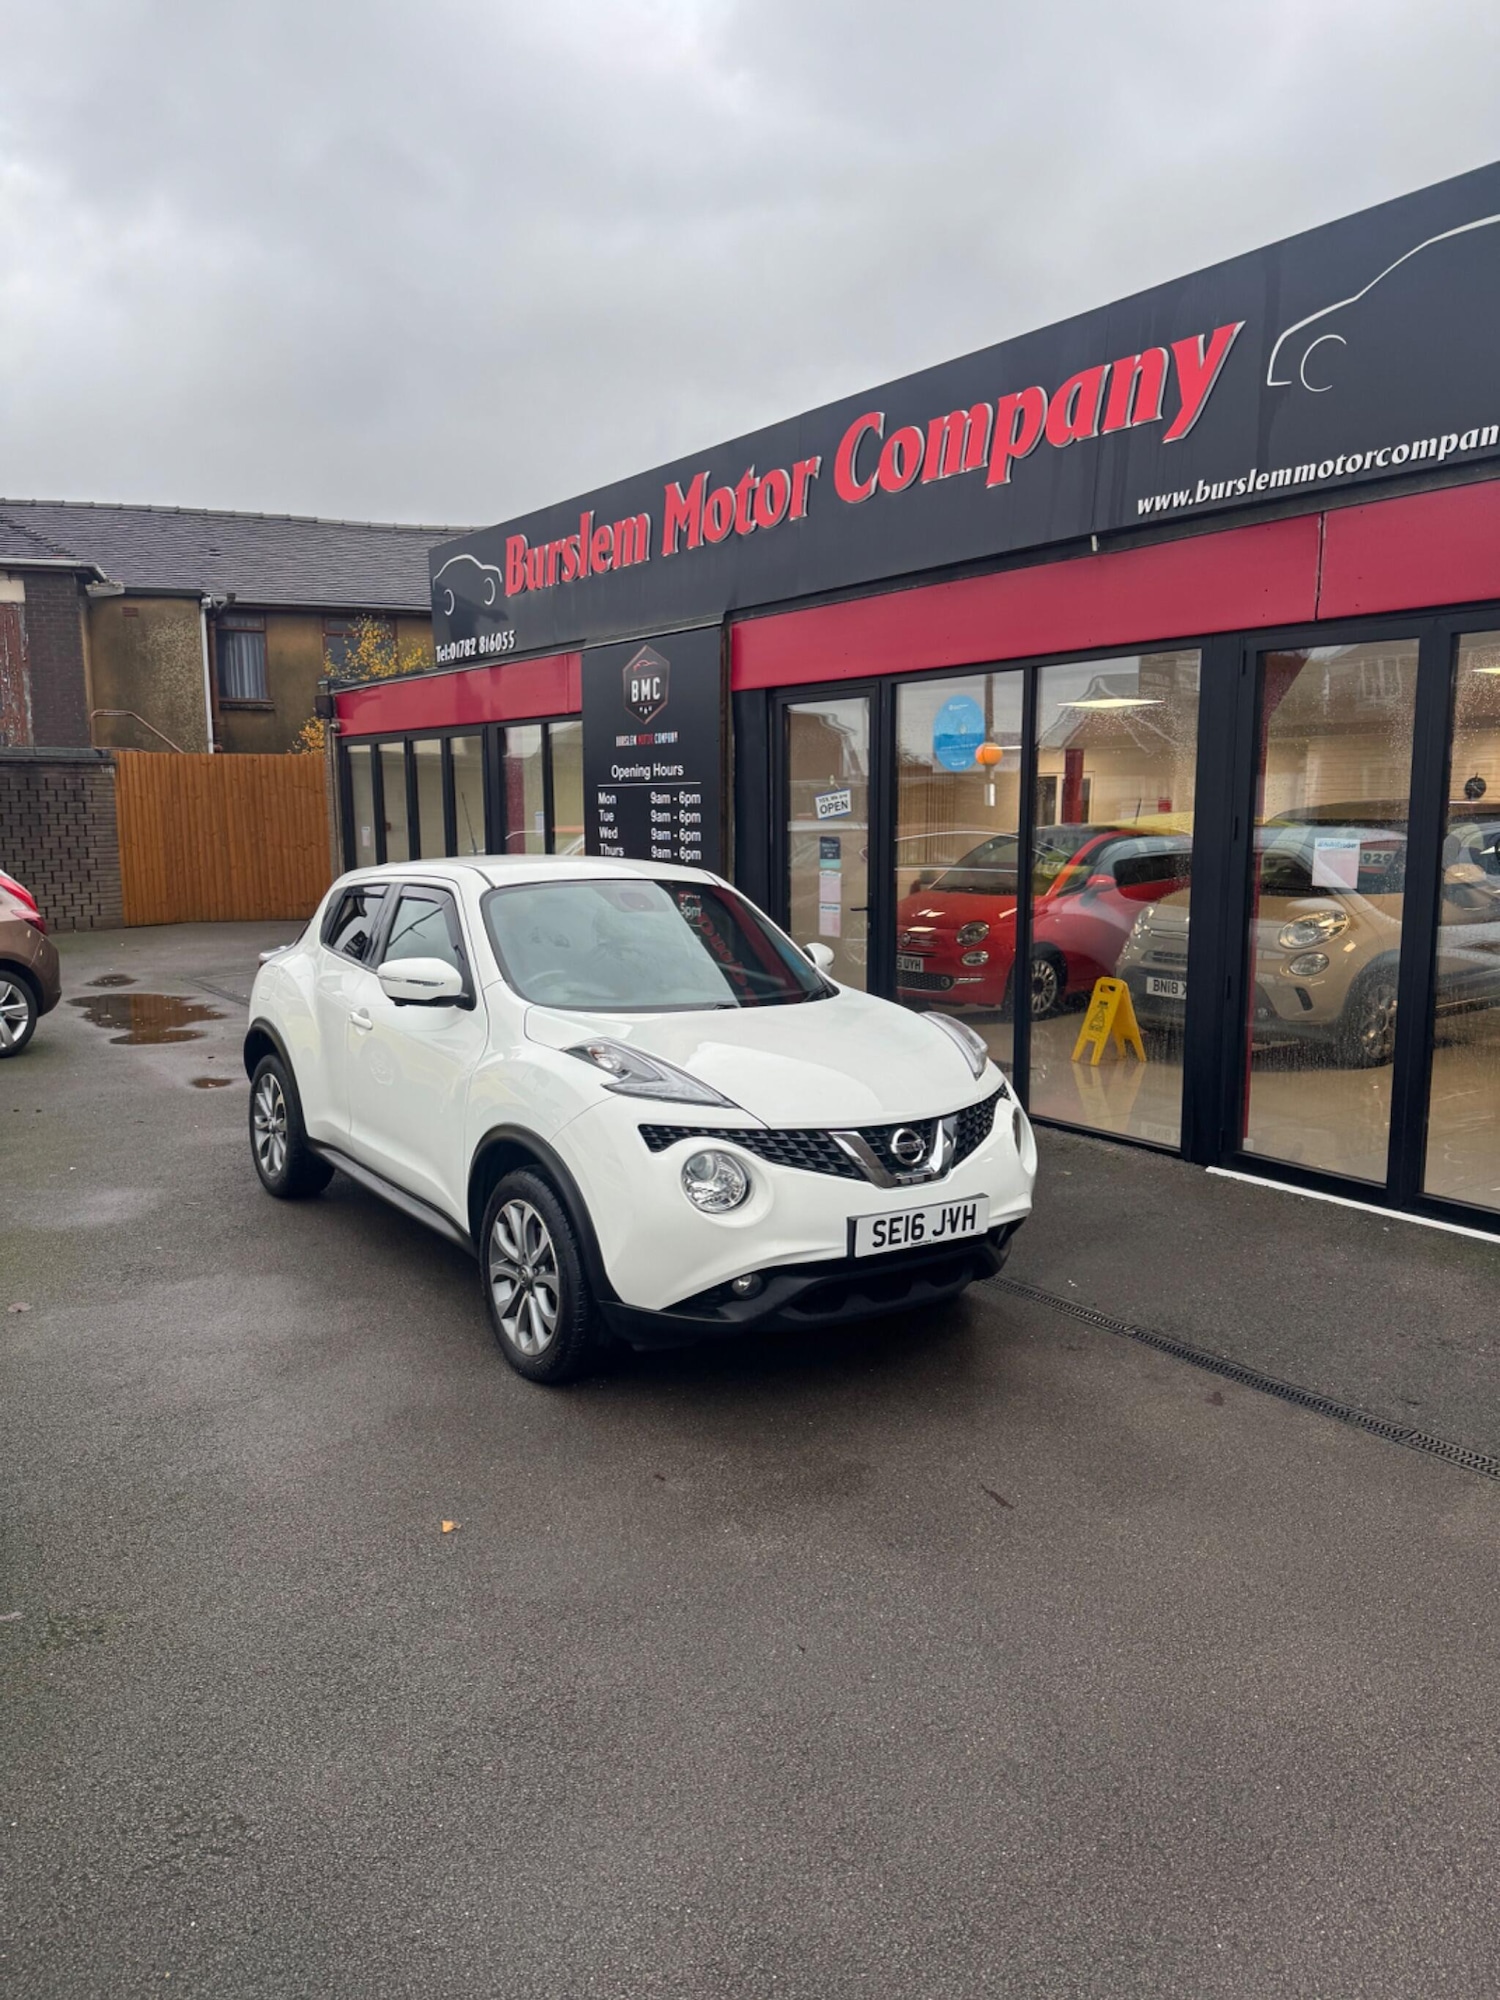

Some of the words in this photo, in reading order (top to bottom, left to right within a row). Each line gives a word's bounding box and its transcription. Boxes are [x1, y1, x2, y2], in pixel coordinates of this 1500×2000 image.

[505, 511, 651, 598] Burslem
[661, 455, 821, 557] Motor
[833, 320, 1247, 504] Company
[435, 636, 477, 662] Tel:01782
[478, 629, 515, 654] 816055
[631, 676, 661, 703] BMC
[611, 763, 651, 781] Opening
[653, 762, 684, 777] Hours
[597, 792, 617, 805] Mon
[650, 791, 671, 804] 9am
[679, 791, 701, 807] 6pm
[820, 800, 849, 815] OPEN
[598, 809, 615, 822] Tue
[650, 809, 671, 823] 9am
[679, 809, 701, 826] 6pm
[599, 826, 619, 839] Wed
[650, 827, 671, 841] 9am
[679, 828, 701, 845] 6pm
[599, 843, 625, 857] Thurs
[650, 845, 671, 859] 9am
[679, 846, 701, 863] 6pm
[1152, 979, 1179, 995] BN18
[871, 1212, 926, 1249] SE16
[932, 1203, 977, 1237] JVH
